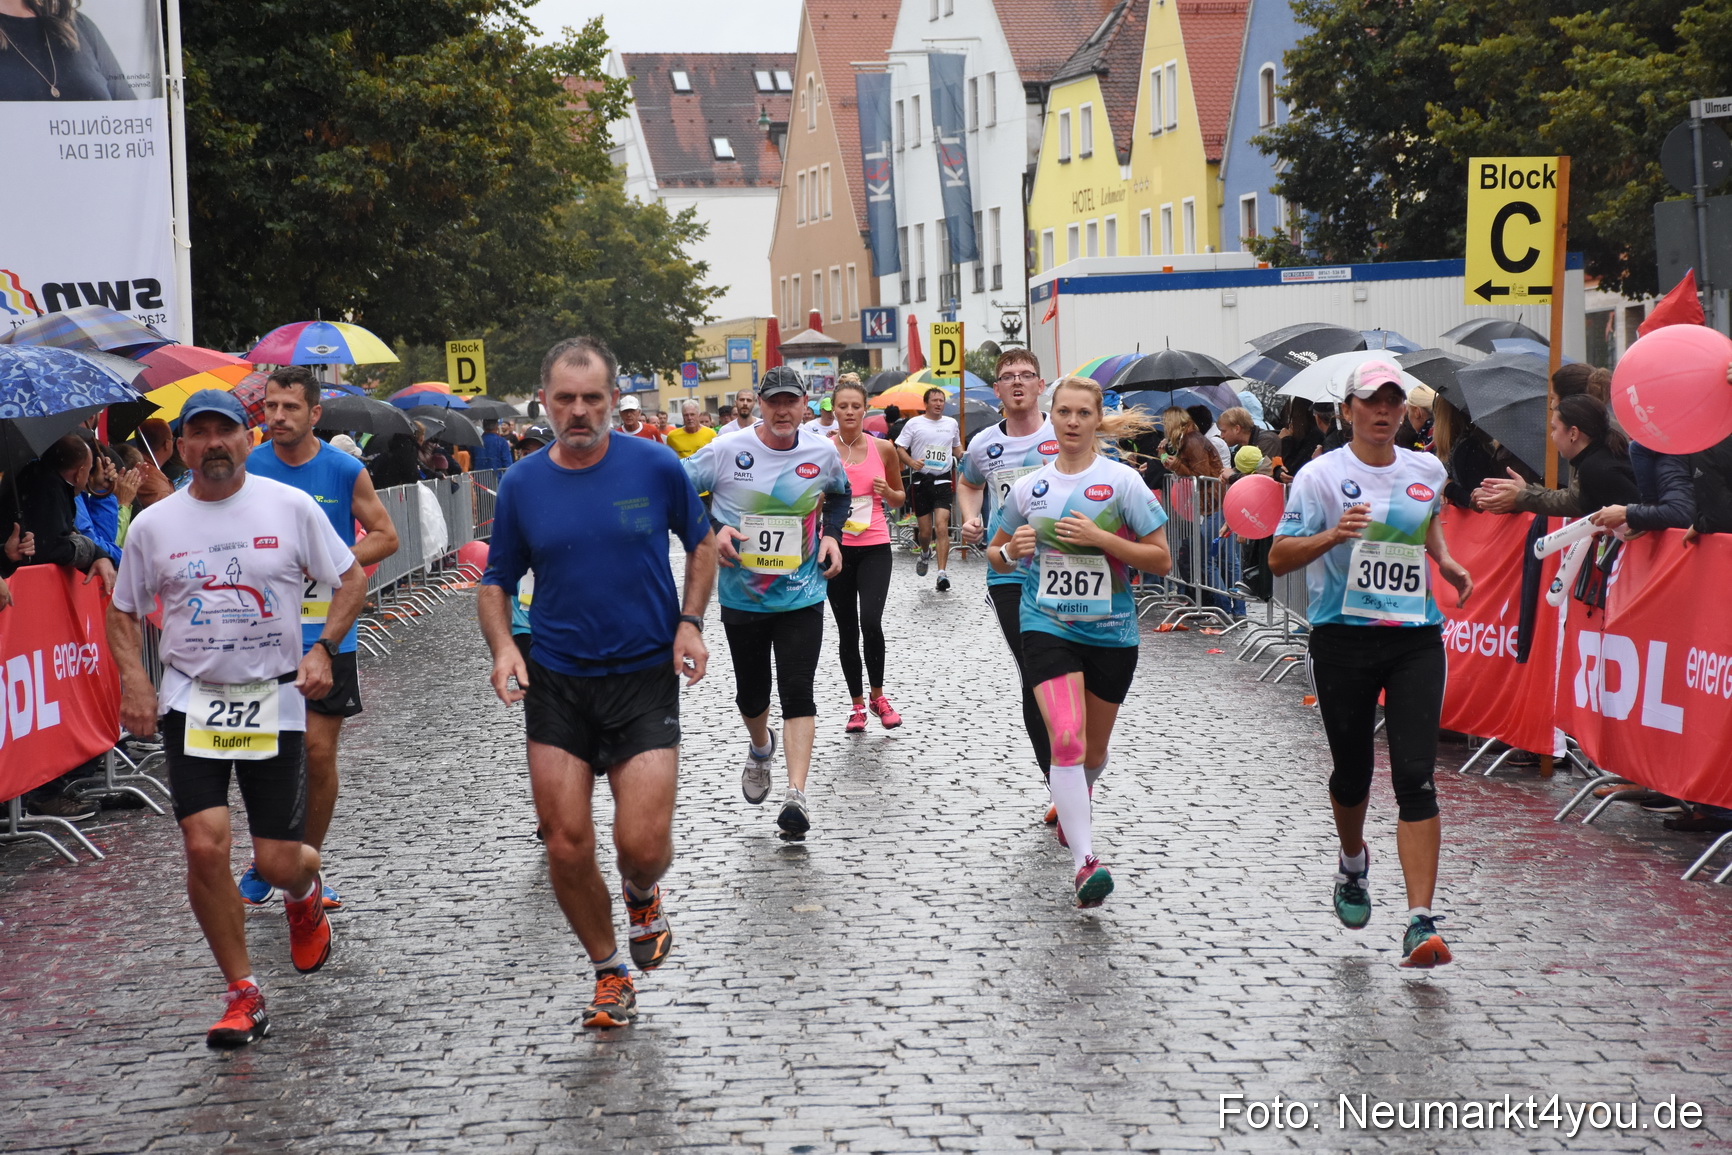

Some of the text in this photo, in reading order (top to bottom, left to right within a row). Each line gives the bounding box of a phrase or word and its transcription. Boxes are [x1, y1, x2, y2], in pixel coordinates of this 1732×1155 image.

[1705, 102, 1732, 114] Ulmer
[1480, 163, 1557, 190] Block
[1072, 188, 1095, 214] HOTEL
[1490, 201, 1542, 274] C
[934, 324, 961, 335] Block
[450, 343, 480, 354] Block
[939, 339, 956, 366] D
[457, 357, 476, 385] D
[926, 450, 946, 462] 3105
[759, 530, 785, 552] 97
[756, 557, 784, 566] Martin
[1068, 556, 1104, 566] BOCK
[304, 575, 318, 599] 2
[1046, 570, 1104, 596] 2367
[1357, 560, 1420, 593] 3095
[188, 598, 211, 626] 2.
[301, 606, 309, 615] in
[1056, 602, 1088, 613] Kristin
[1362, 595, 1399, 609] Brigitte
[206, 700, 261, 728] 252
[212, 736, 252, 748] Rudolf
